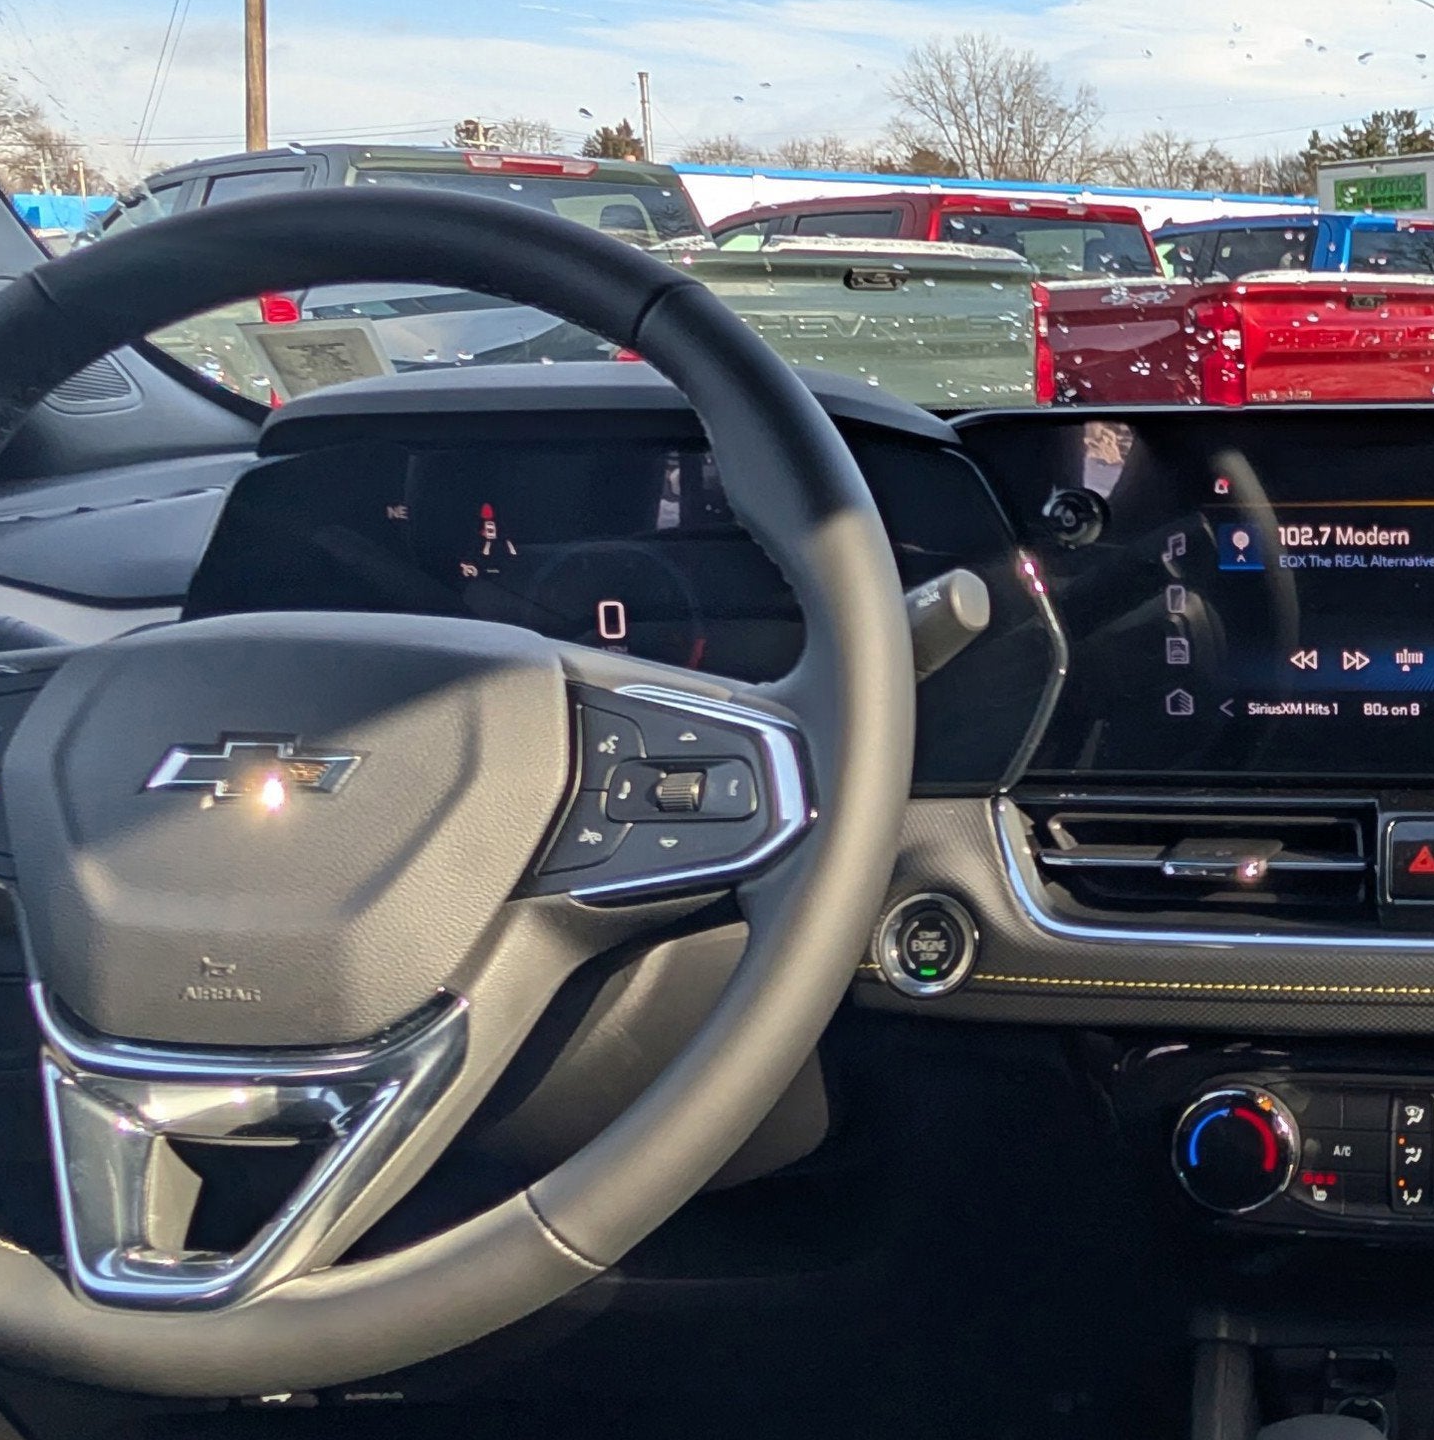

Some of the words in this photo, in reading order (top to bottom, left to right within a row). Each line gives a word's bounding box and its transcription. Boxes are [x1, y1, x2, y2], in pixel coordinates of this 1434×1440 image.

[386, 505, 409, 520] NE
[1278, 526, 1332, 546] 102.7
[1336, 525, 1410, 546] Modern
[1279, 556, 1306, 568] EQX
[1308, 555, 1332, 568] The
[1335, 555, 1367, 567] REAL
[598, 600, 627, 639] 0
[1247, 703, 1303, 716] SiriusXM
[1305, 703, 1330, 715] Hits
[1332, 703, 1339, 715] 1
[1363, 703, 1389, 716] 80s
[1391, 705, 1408, 716] on
[1410, 703, 1420, 716] 8
[1333, 1145, 1352, 1157] A/C
